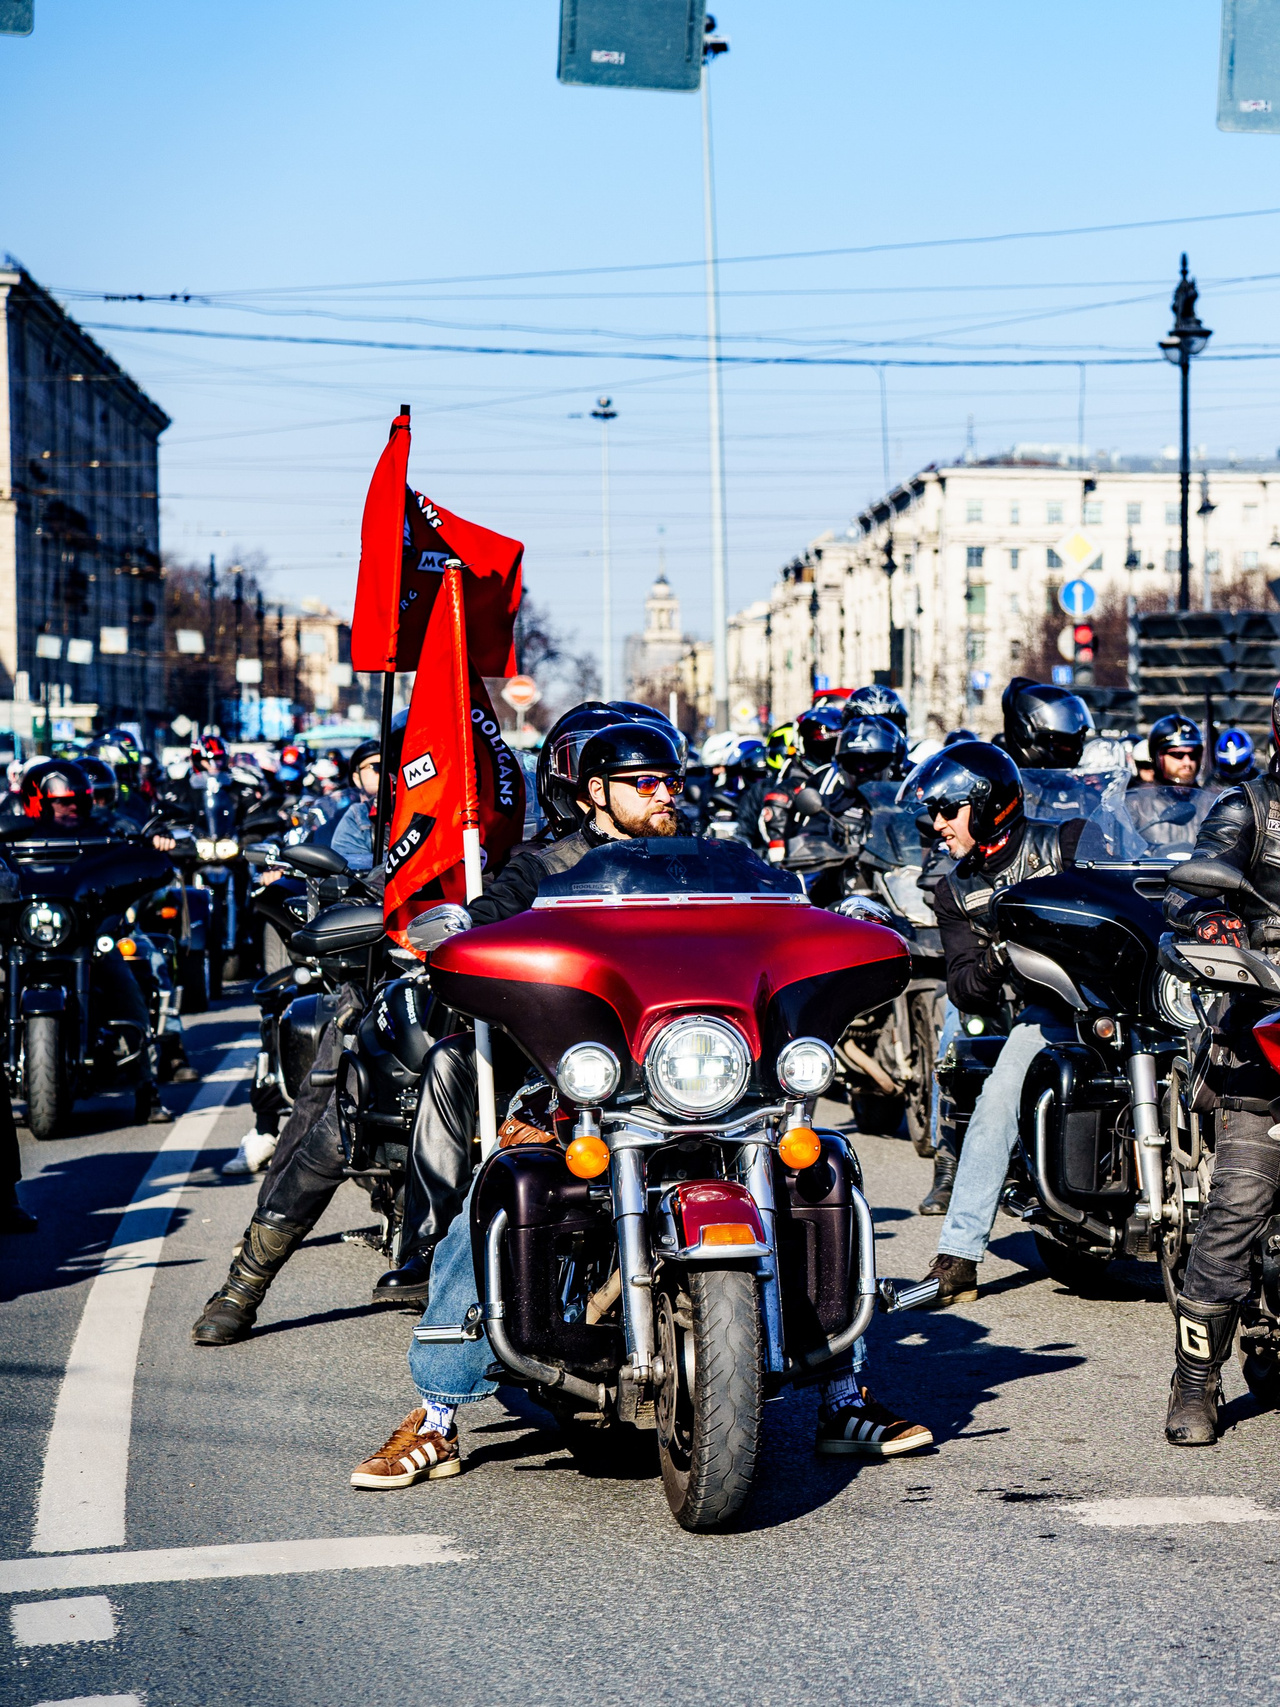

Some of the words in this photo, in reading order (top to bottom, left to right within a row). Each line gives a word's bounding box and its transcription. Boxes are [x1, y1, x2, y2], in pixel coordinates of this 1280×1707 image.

[416, 494, 443, 529] ANS
[408, 761, 431, 782] MC
[470, 708, 513, 807] OOLIGANS
[385, 828, 421, 875] CLUB
[1179, 1315, 1211, 1359] G
